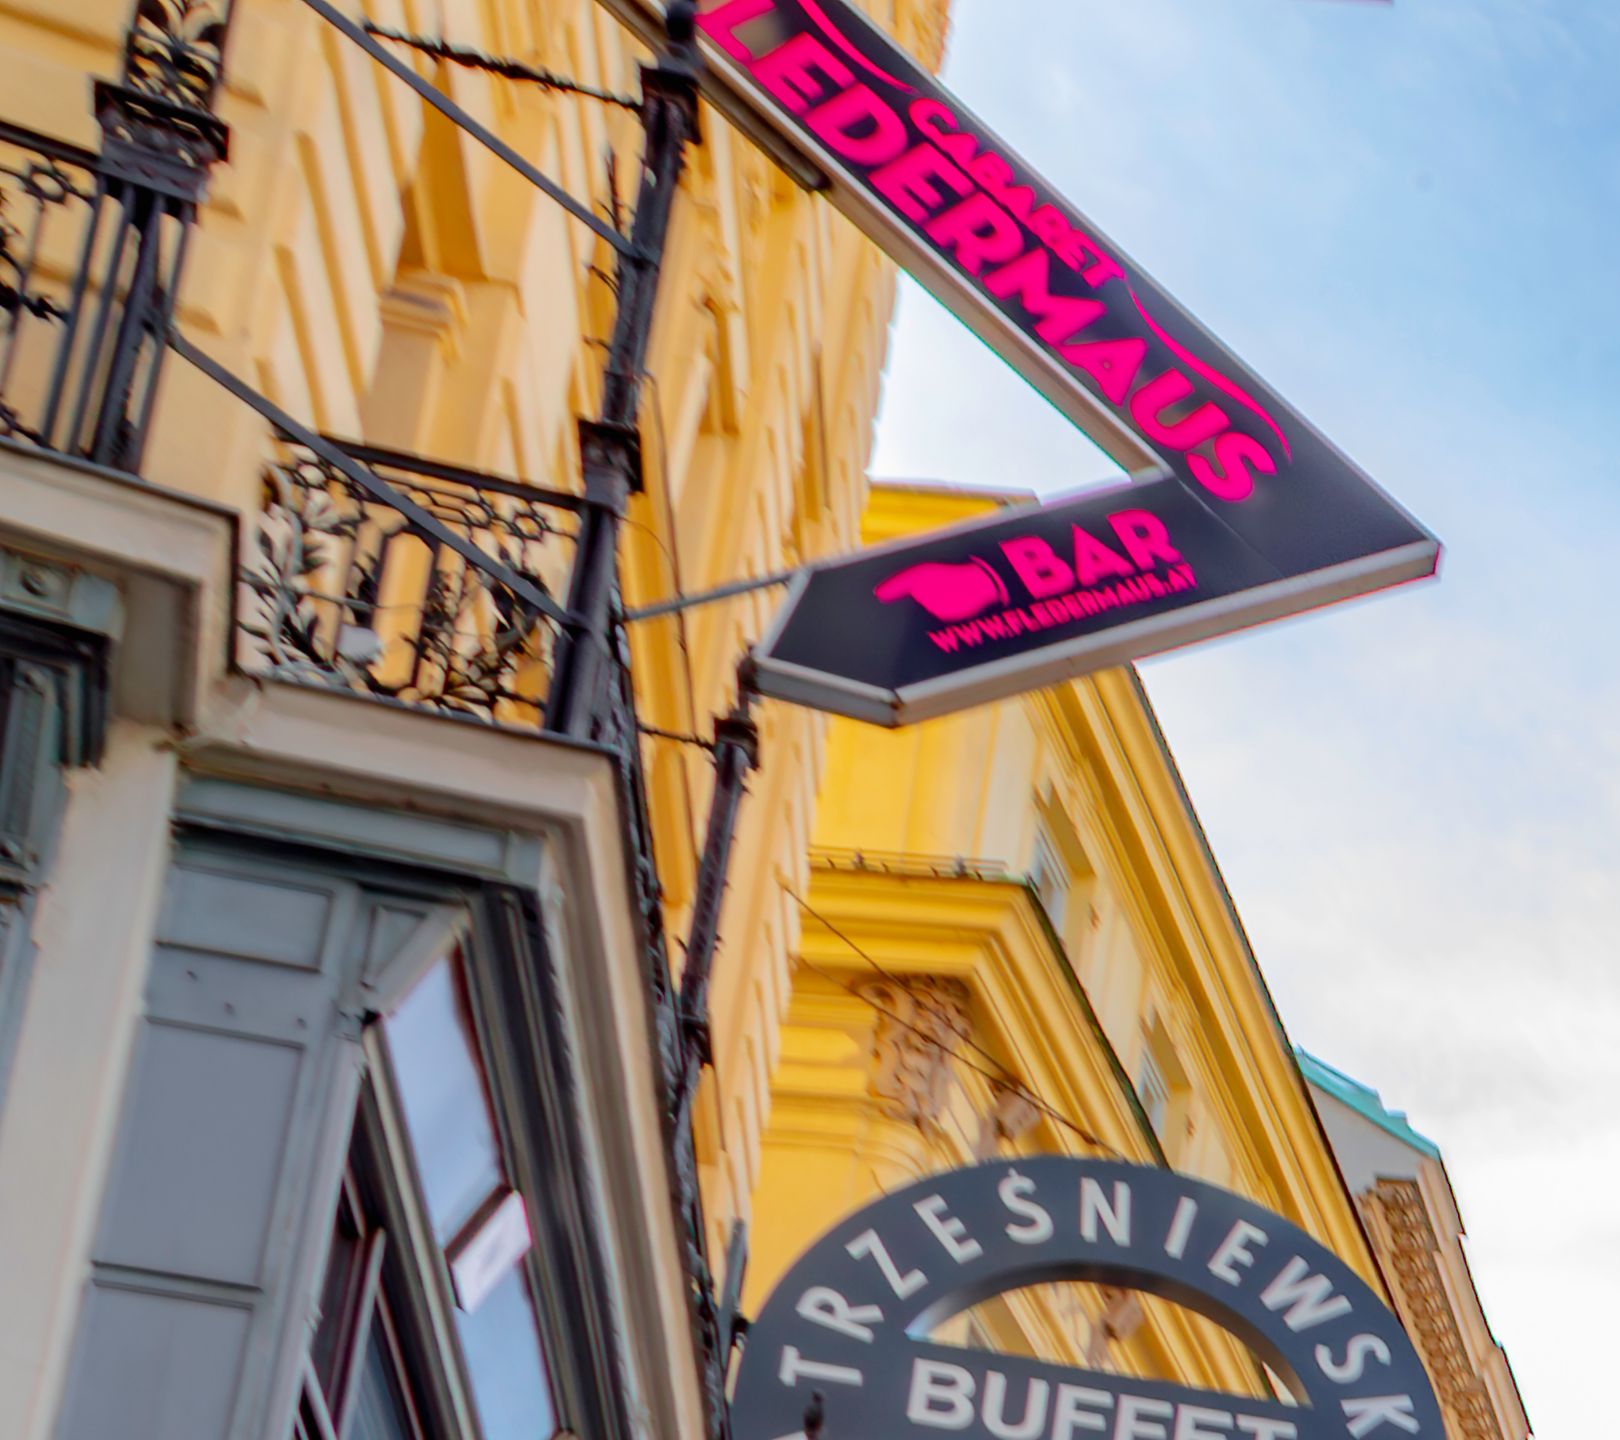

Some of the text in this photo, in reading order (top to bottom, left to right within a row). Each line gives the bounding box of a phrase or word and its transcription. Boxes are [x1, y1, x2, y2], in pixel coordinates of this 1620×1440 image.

[908, 98, 1125, 290] CABARET
[1000, 508, 1183, 600] BAR
[927, 562, 1198, 653] WWW.FLEDERMAUS.AT
